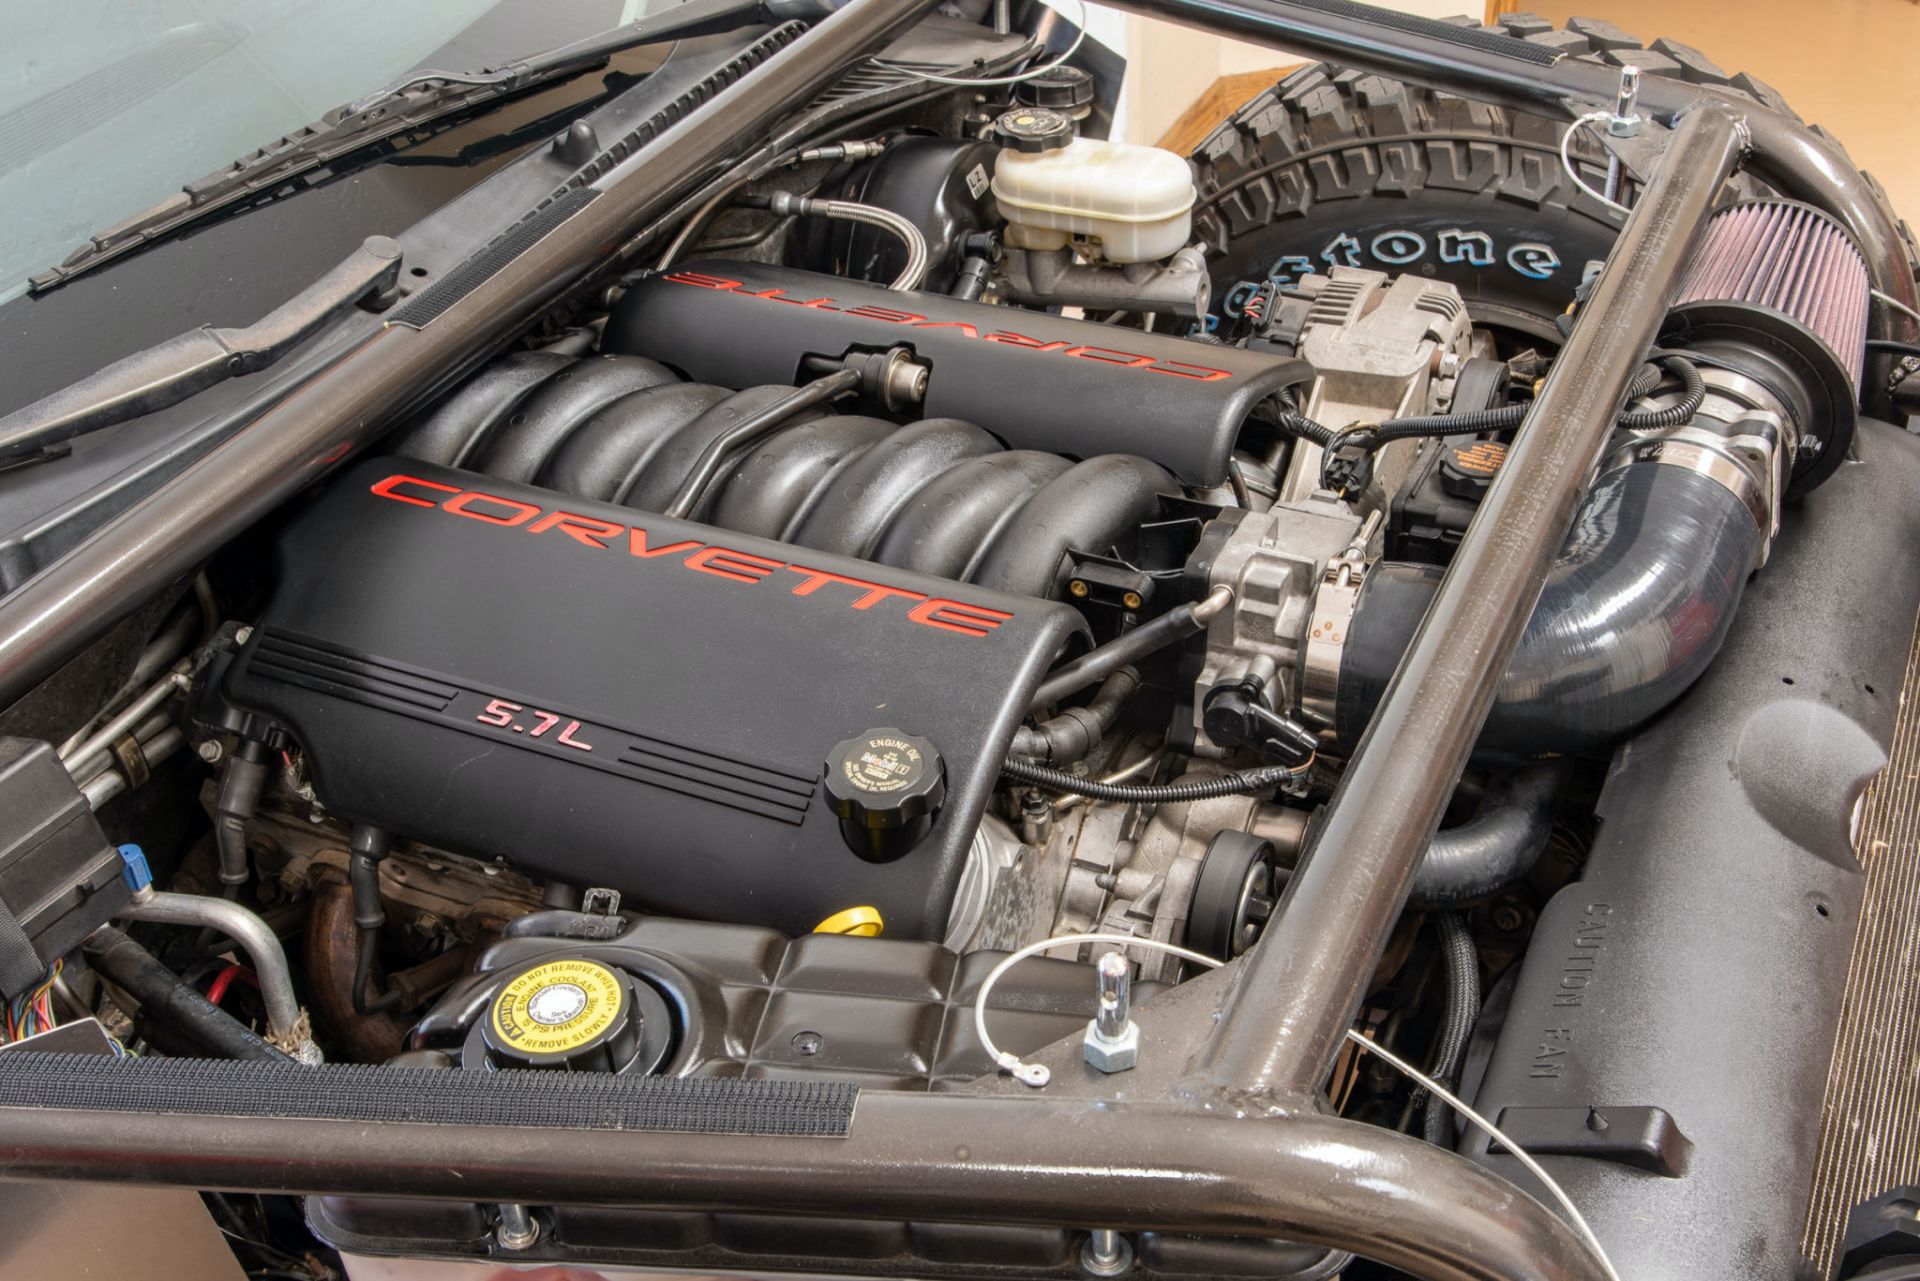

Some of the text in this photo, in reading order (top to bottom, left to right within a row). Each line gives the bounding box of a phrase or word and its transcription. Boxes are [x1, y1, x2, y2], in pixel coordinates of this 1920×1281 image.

[662, 271, 1233, 381] CORVETTE
[369, 474, 1015, 637] CORVETTE
[476, 699, 592, 752] 5.7L
[869, 739, 910, 752] ENGINE
[906, 749, 920, 762] OIL
[512, 963, 617, 1007] DO NOT REMOVE WHEN HOT
[516, 975, 598, 1012] ENGINE COOLANT
[1529, 903, 1613, 1078] CAUTION FAN
[501, 995, 516, 1030] CAUTION
[524, 1014, 609, 1049] REMOVE SLOWLY
[532, 1024, 550, 1034] PSI
[552, 997, 598, 1033] PRESSURE
